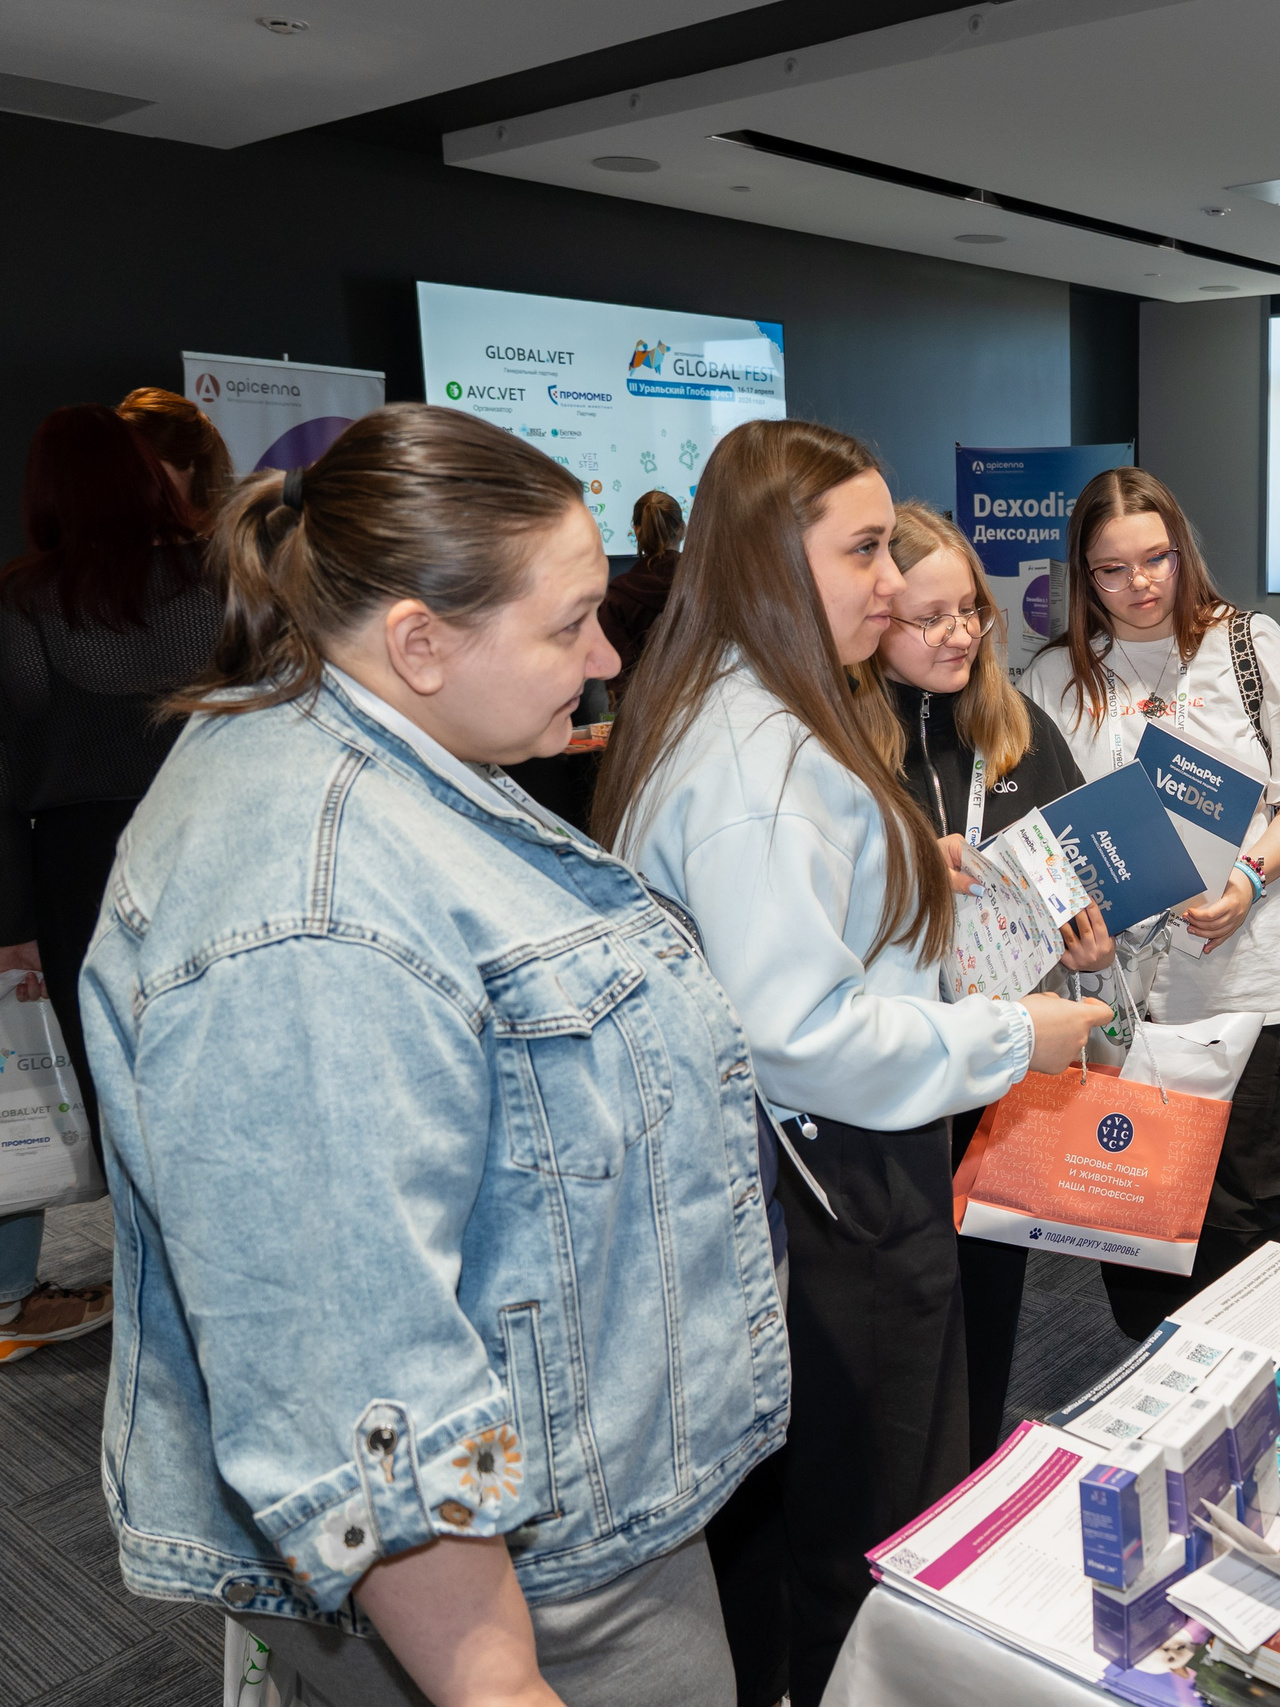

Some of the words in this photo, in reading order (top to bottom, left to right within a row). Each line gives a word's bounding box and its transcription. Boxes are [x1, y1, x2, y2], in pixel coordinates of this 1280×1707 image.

[485, 345, 575, 366] GLOBAL.VET
[673, 358, 740, 381] GLOBAL
[745, 364, 775, 382] FEST
[226, 378, 301, 397] apicenna
[467, 385, 526, 401] AVC.VET
[639, 383, 685, 396] Уральский
[686, 386, 734, 399] Глобалфест
[578, 461, 599, 469] STEM
[986, 462, 1024, 471] apicenna
[973, 525, 1060, 544] Дексодия
[1177, 704, 1185, 732] AVC.VE
[1171, 753, 1223, 787] AlphaPet
[973, 772, 983, 808] AVC.VET
[1156, 767, 1224, 821] VetDiet
[1096, 830, 1130, 881] AlphaPet
[1056, 824, 1113, 912] VetDiet
[17, 1055, 72, 1072] GLOB
[0, 1105, 51, 1118] OBAL.VET
[1064, 1153, 1113, 1171] ЗДОРОВЬЕ
[1114, 1163, 1149, 1178] ЛЮДЕЙ
[1069, 1168, 1076, 1176] И
[1078, 1170, 1133, 1188] ЖИВОТНЫХ
[1058, 1180, 1086, 1193] НАША
[1087, 1186, 1145, 1204] ПРОФЕССИЯ
[1044, 1231, 1076, 1245] ПОДАРИ
[1075, 1237, 1101, 1249] ДРУГУ
[1101, 1242, 1141, 1257] ЗДОРОВЬЕ
